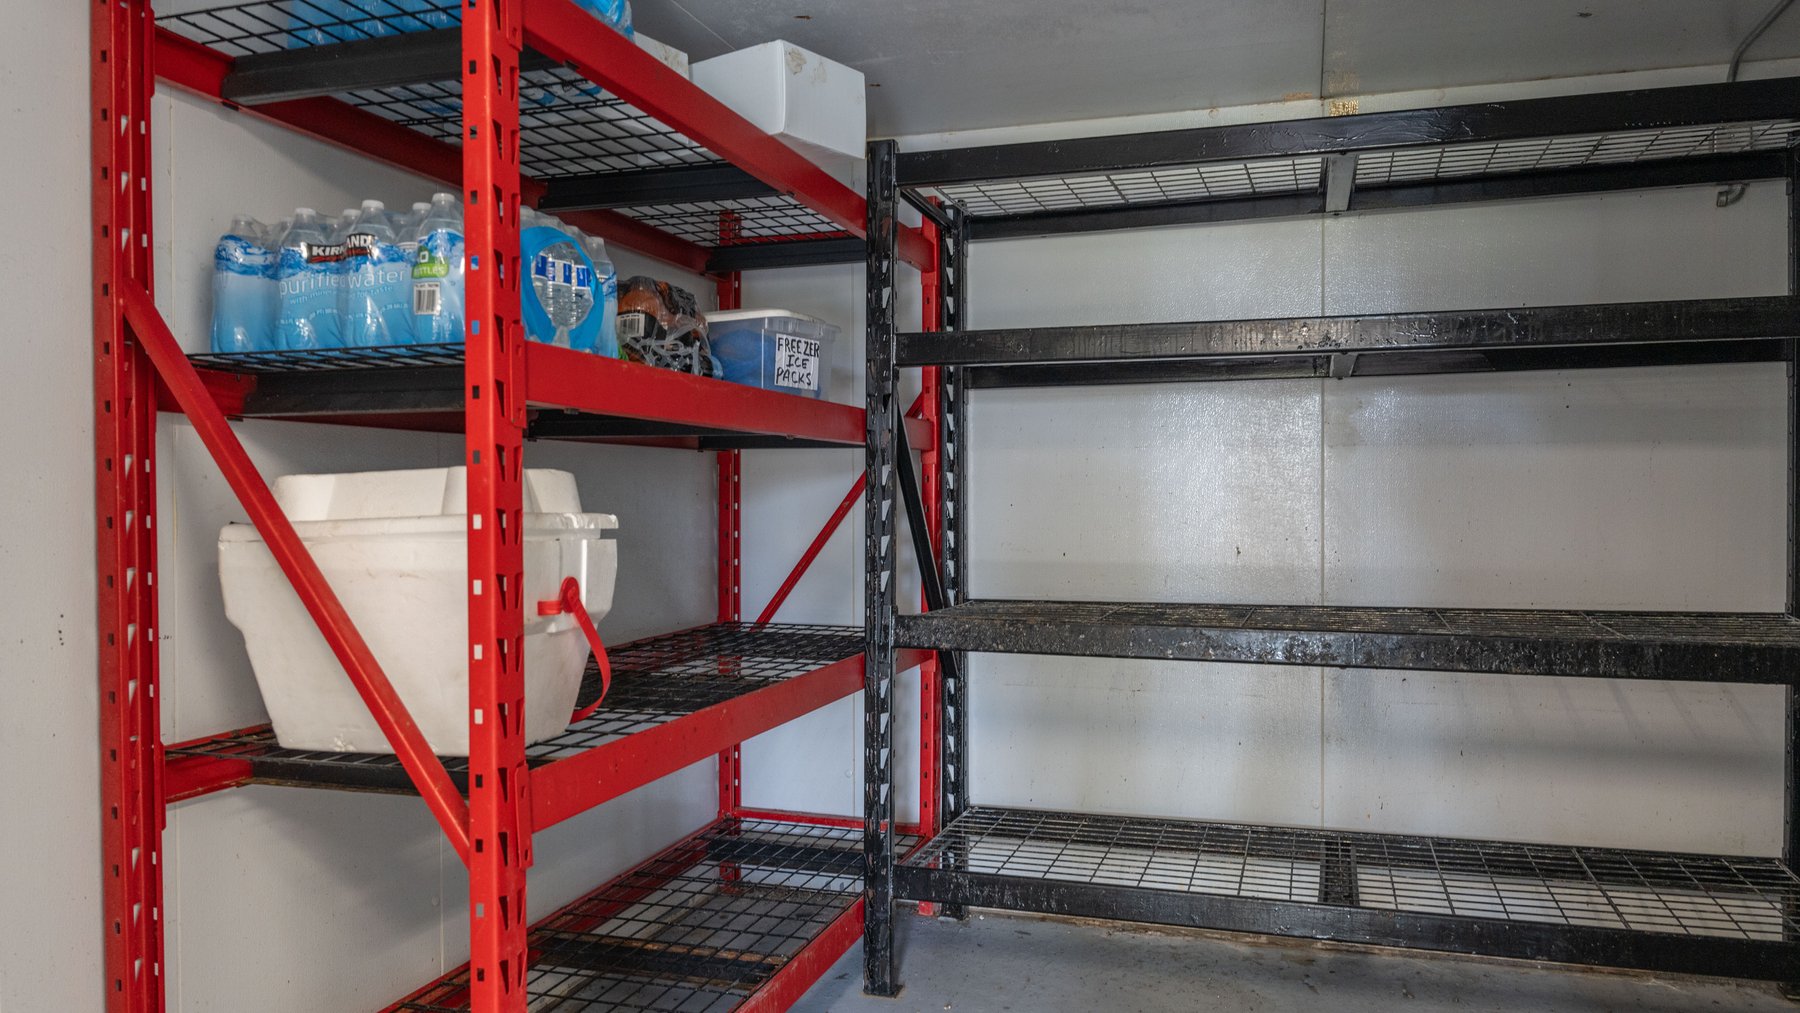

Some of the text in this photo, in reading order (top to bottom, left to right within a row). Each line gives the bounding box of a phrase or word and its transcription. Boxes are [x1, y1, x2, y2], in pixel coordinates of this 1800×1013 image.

[348, 269, 404, 289] water
[777, 337, 820, 358] FREEZER
[786, 354, 809, 369] ICE
[776, 366, 812, 387] PACKS
